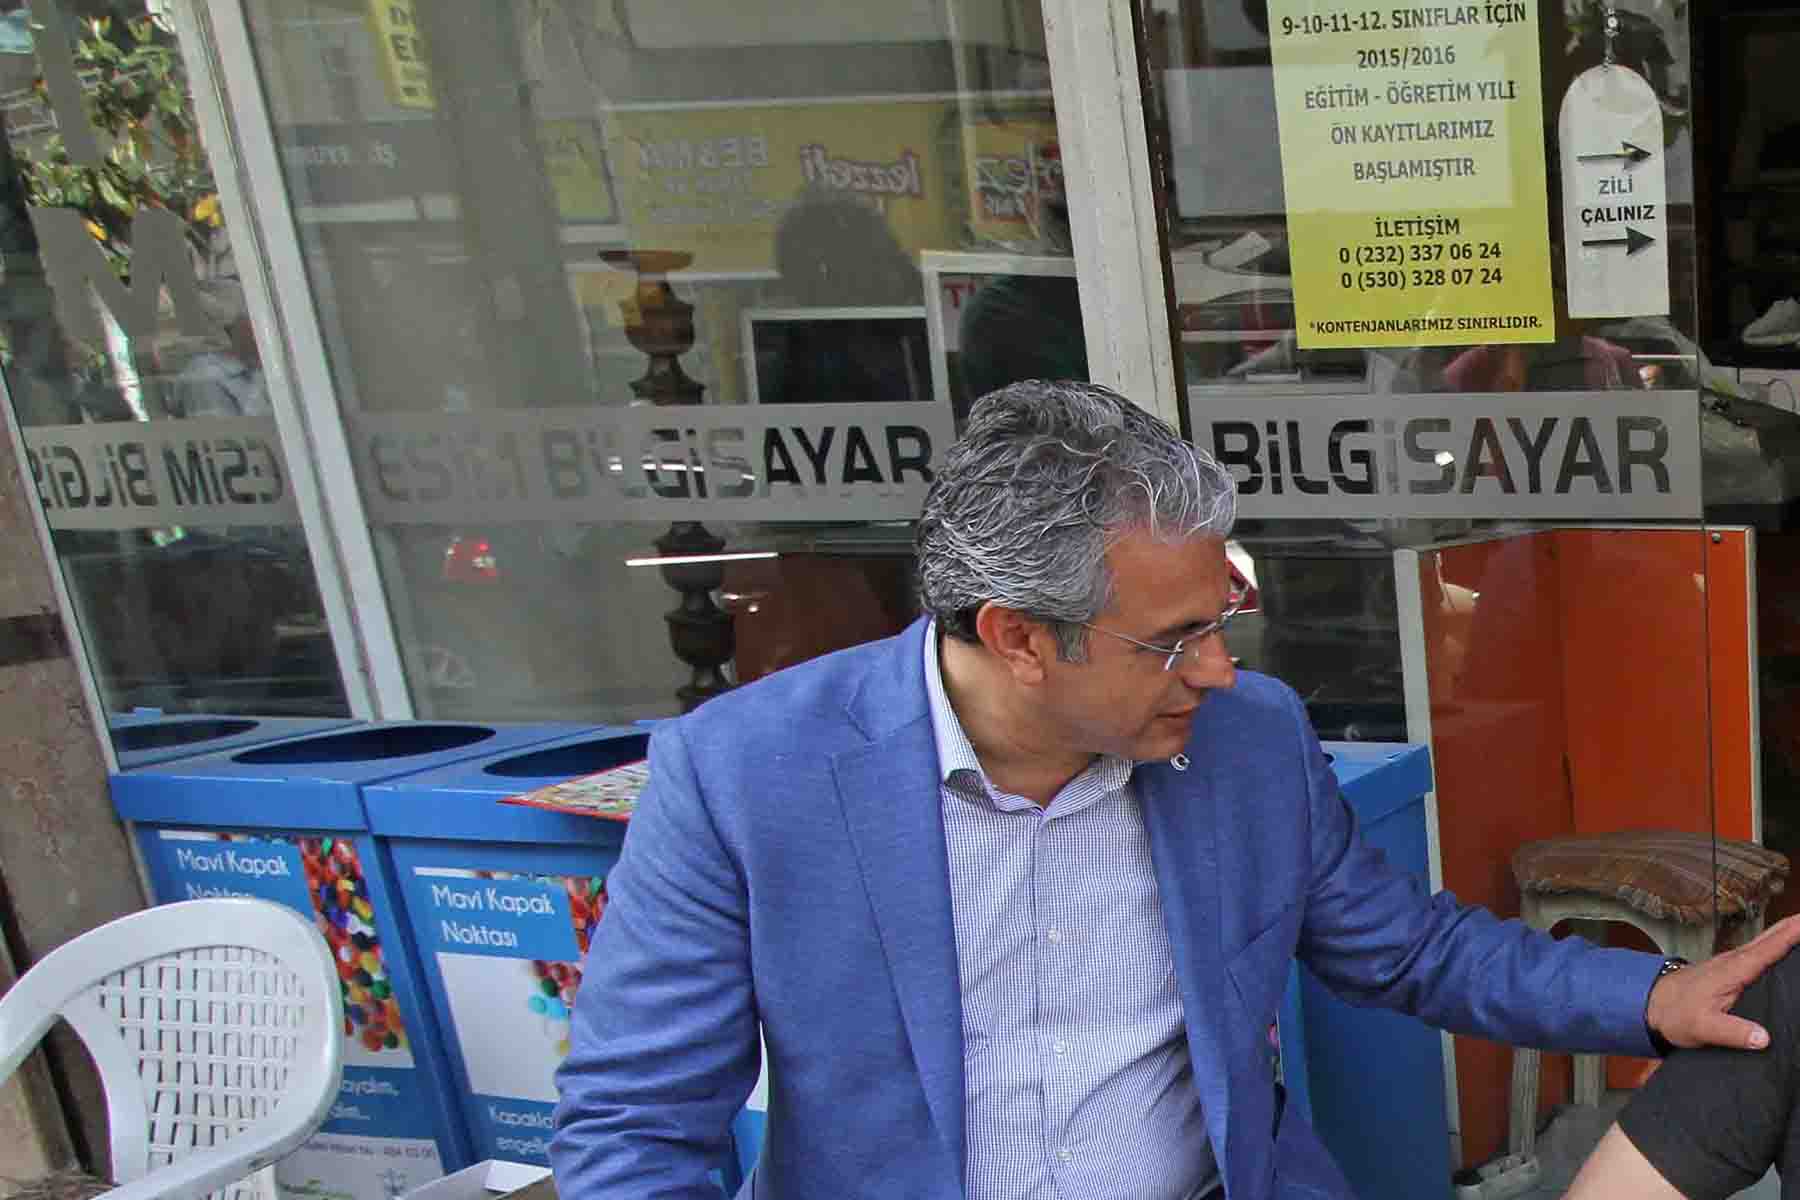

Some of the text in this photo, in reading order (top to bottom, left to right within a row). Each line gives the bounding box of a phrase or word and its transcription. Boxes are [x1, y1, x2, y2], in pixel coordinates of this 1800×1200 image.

[1282, 11, 1387, 35] 9-10-11-12.
[1391, 5, 1480, 30] SINIFLAR
[1357, 45, 1456, 70] 2015/2016
[1304, 84, 1369, 109] EĞİTİM
[1386, 79, 1472, 105] ÖĞRETİM
[1476, 80, 1517, 101] YILI
[1331, 119, 1495, 145] ÖN KAYITLARIMIZ
[1353, 157, 1476, 184] BAŞLAMIŞTIR
[1375, 215, 1461, 239] İLETİŞİM
[1581, 204, 1656, 227] ÇALINIZ
[1339, 242, 1501, 266] 0 (232) 337 06 24
[1341, 268, 1503, 291] 0 (530) 328 07 24
[1457, 316, 1543, 330] SINIRLIDIR.
[177, 847, 291, 880] Mavi Kapak
[432, 884, 556, 917] Mavi Kapak
[441, 919, 519, 948] Noktası
